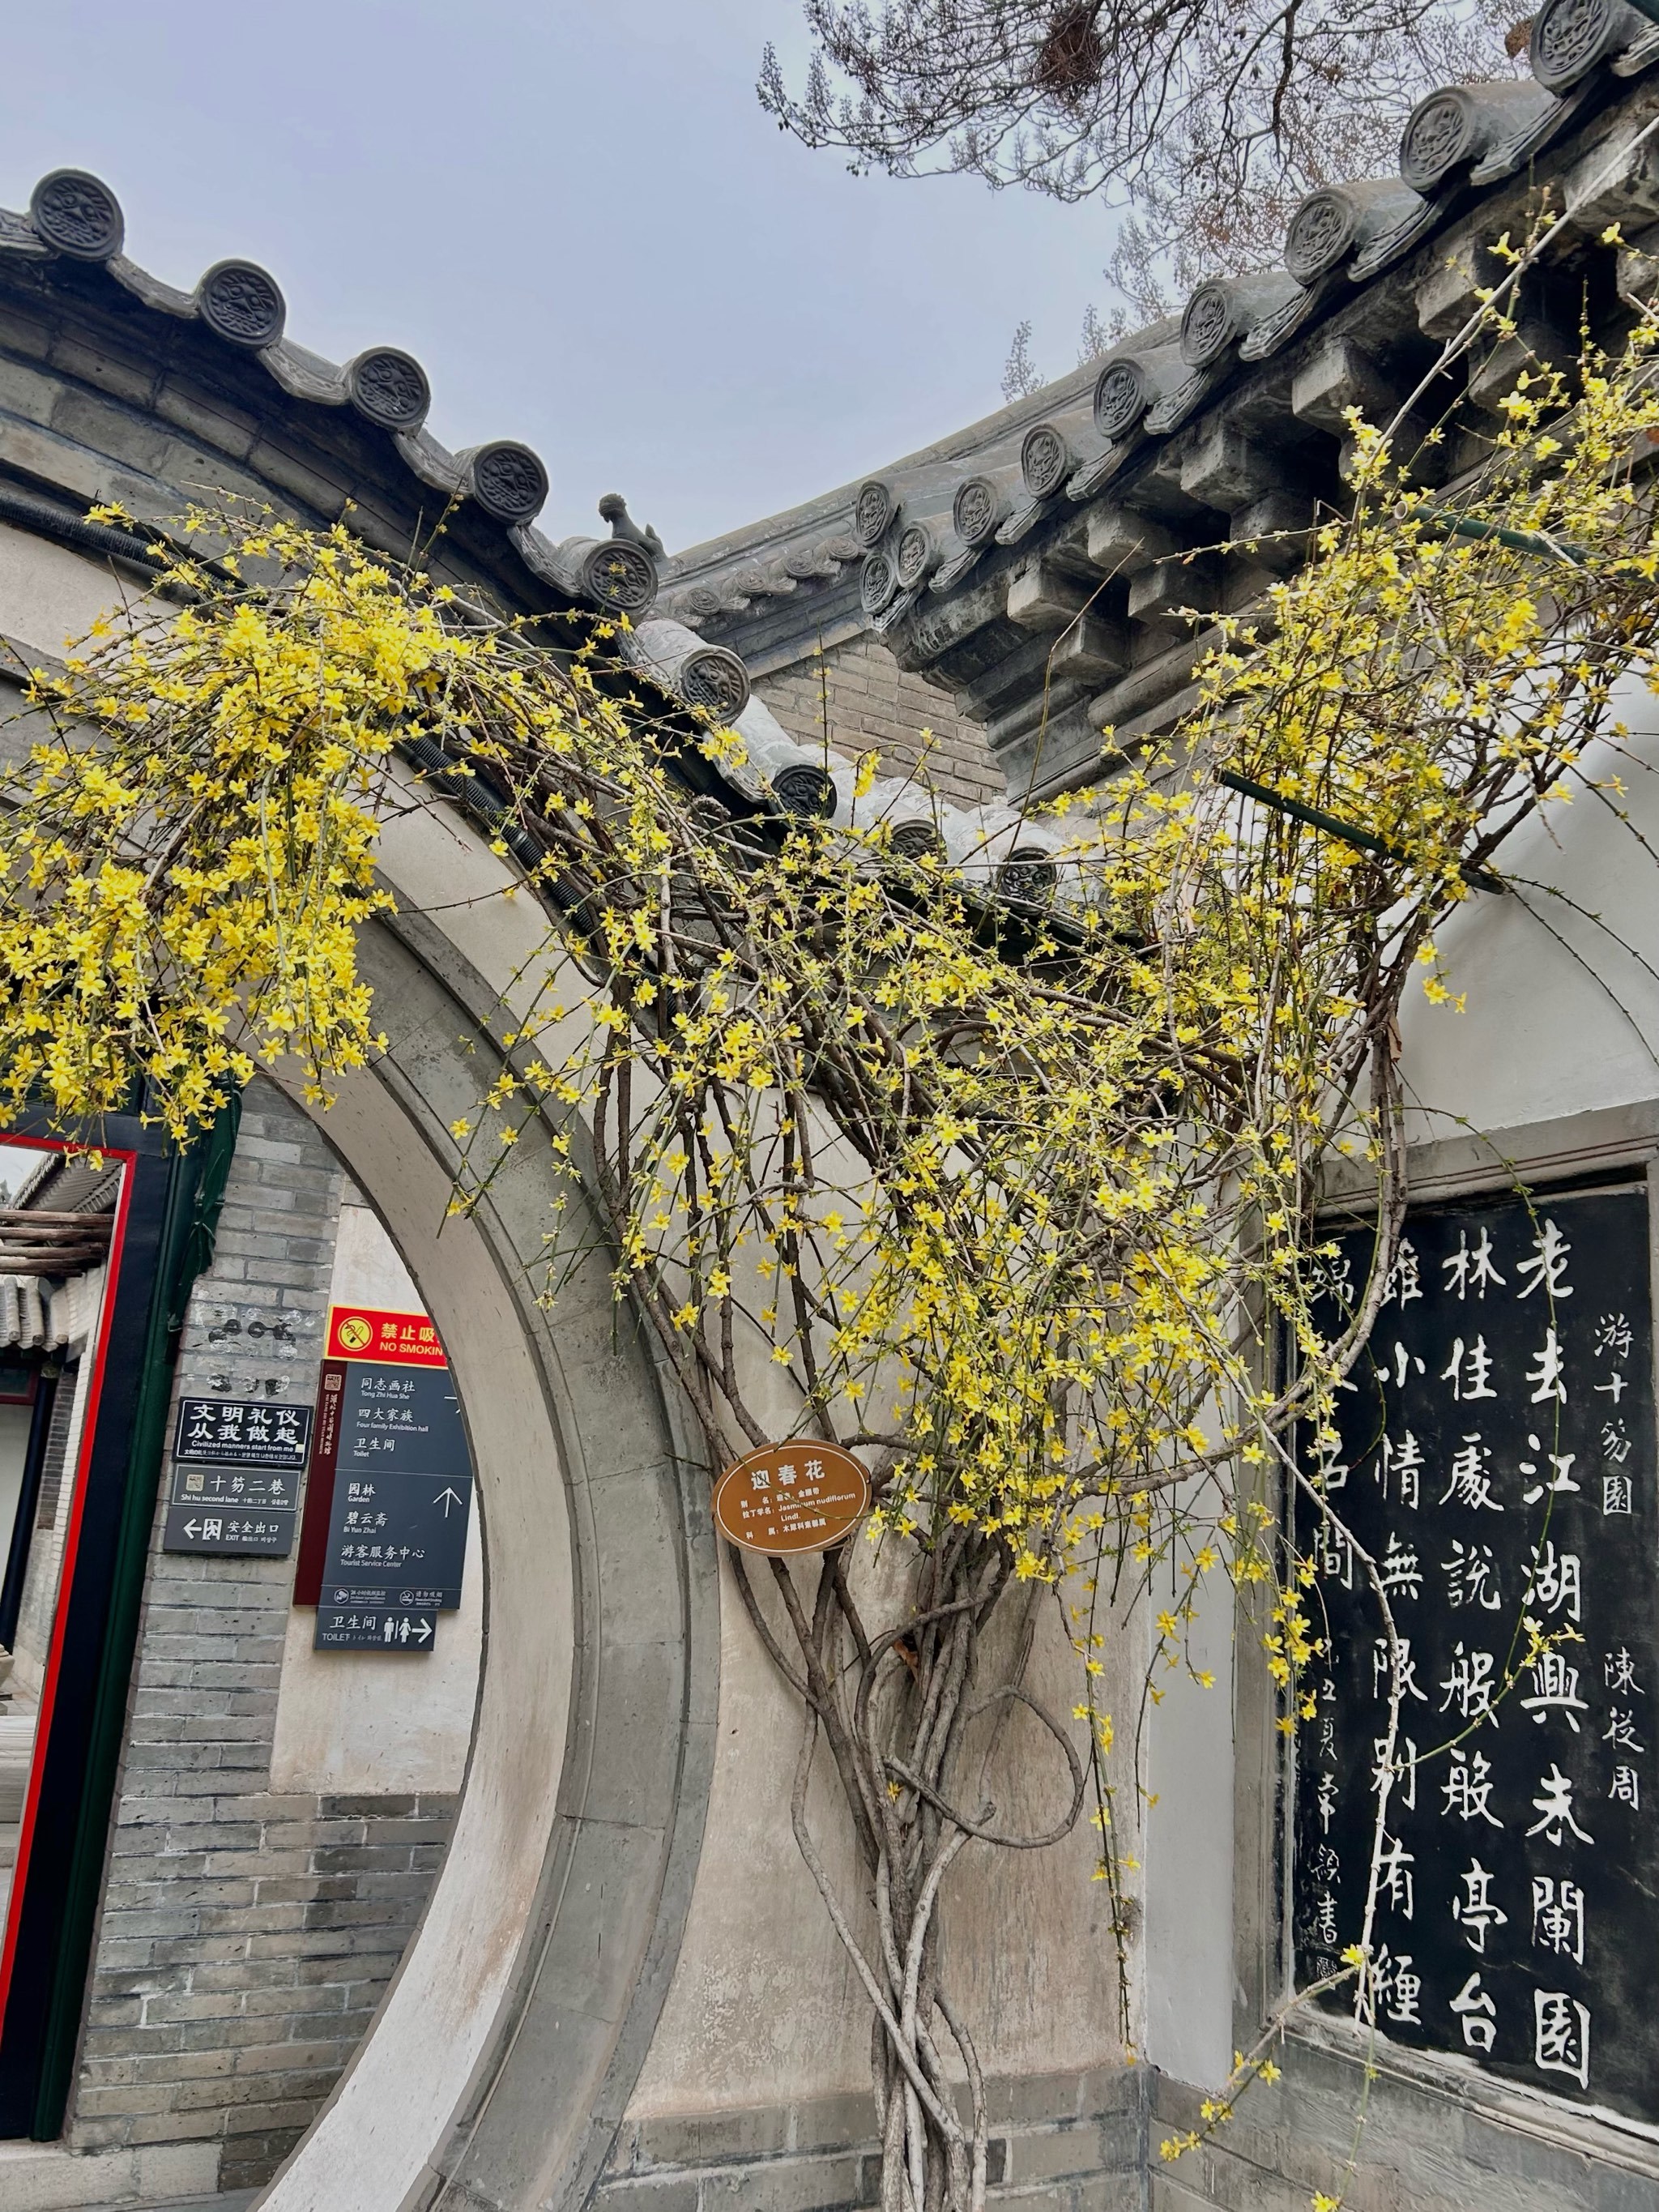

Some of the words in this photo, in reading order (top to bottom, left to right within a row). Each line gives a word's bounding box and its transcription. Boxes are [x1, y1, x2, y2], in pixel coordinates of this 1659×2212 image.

[381, 1322, 441, 1344] 禁止吸
[379, 1341, 397, 1352] NO
[399, 1343, 443, 1356] SMOKIN
[361, 1377, 416, 1393] 同志画社
[361, 1390, 375, 1399] Tong
[376, 1390, 386, 1399] Zhi
[190, 1404, 301, 1427] 文明礼仪
[358, 1407, 414, 1423] 四大家族
[188, 1422, 298, 1445] 从我做起
[370, 1422, 389, 1431] family
[389, 1424, 417, 1433] Exhibition
[191, 1440, 221, 1449] Civilized
[221, 1442, 250, 1450] manners
[251, 1443, 267, 1451] start
[354, 1437, 395, 1452] 卫生间
[751, 1459, 825, 1491] 迎春花
[210, 1475, 286, 1495] 十笏二巷
[348, 1482, 377, 1497] 园林
[202, 1495, 224, 1503] second
[348, 1495, 370, 1503] Garden
[817, 1492, 856, 1505] nudiflorum
[345, 1511, 389, 1527] 碧云斋
[227, 1520, 279, 1534] 安全出口
[225, 1534, 240, 1542] EXIT
[341, 1544, 425, 1561] 游客服务中心
[340, 1559, 360, 1567] Tourist
[330, 1614, 377, 1630] 卫生间
[322, 1633, 350, 1642] TOILET
